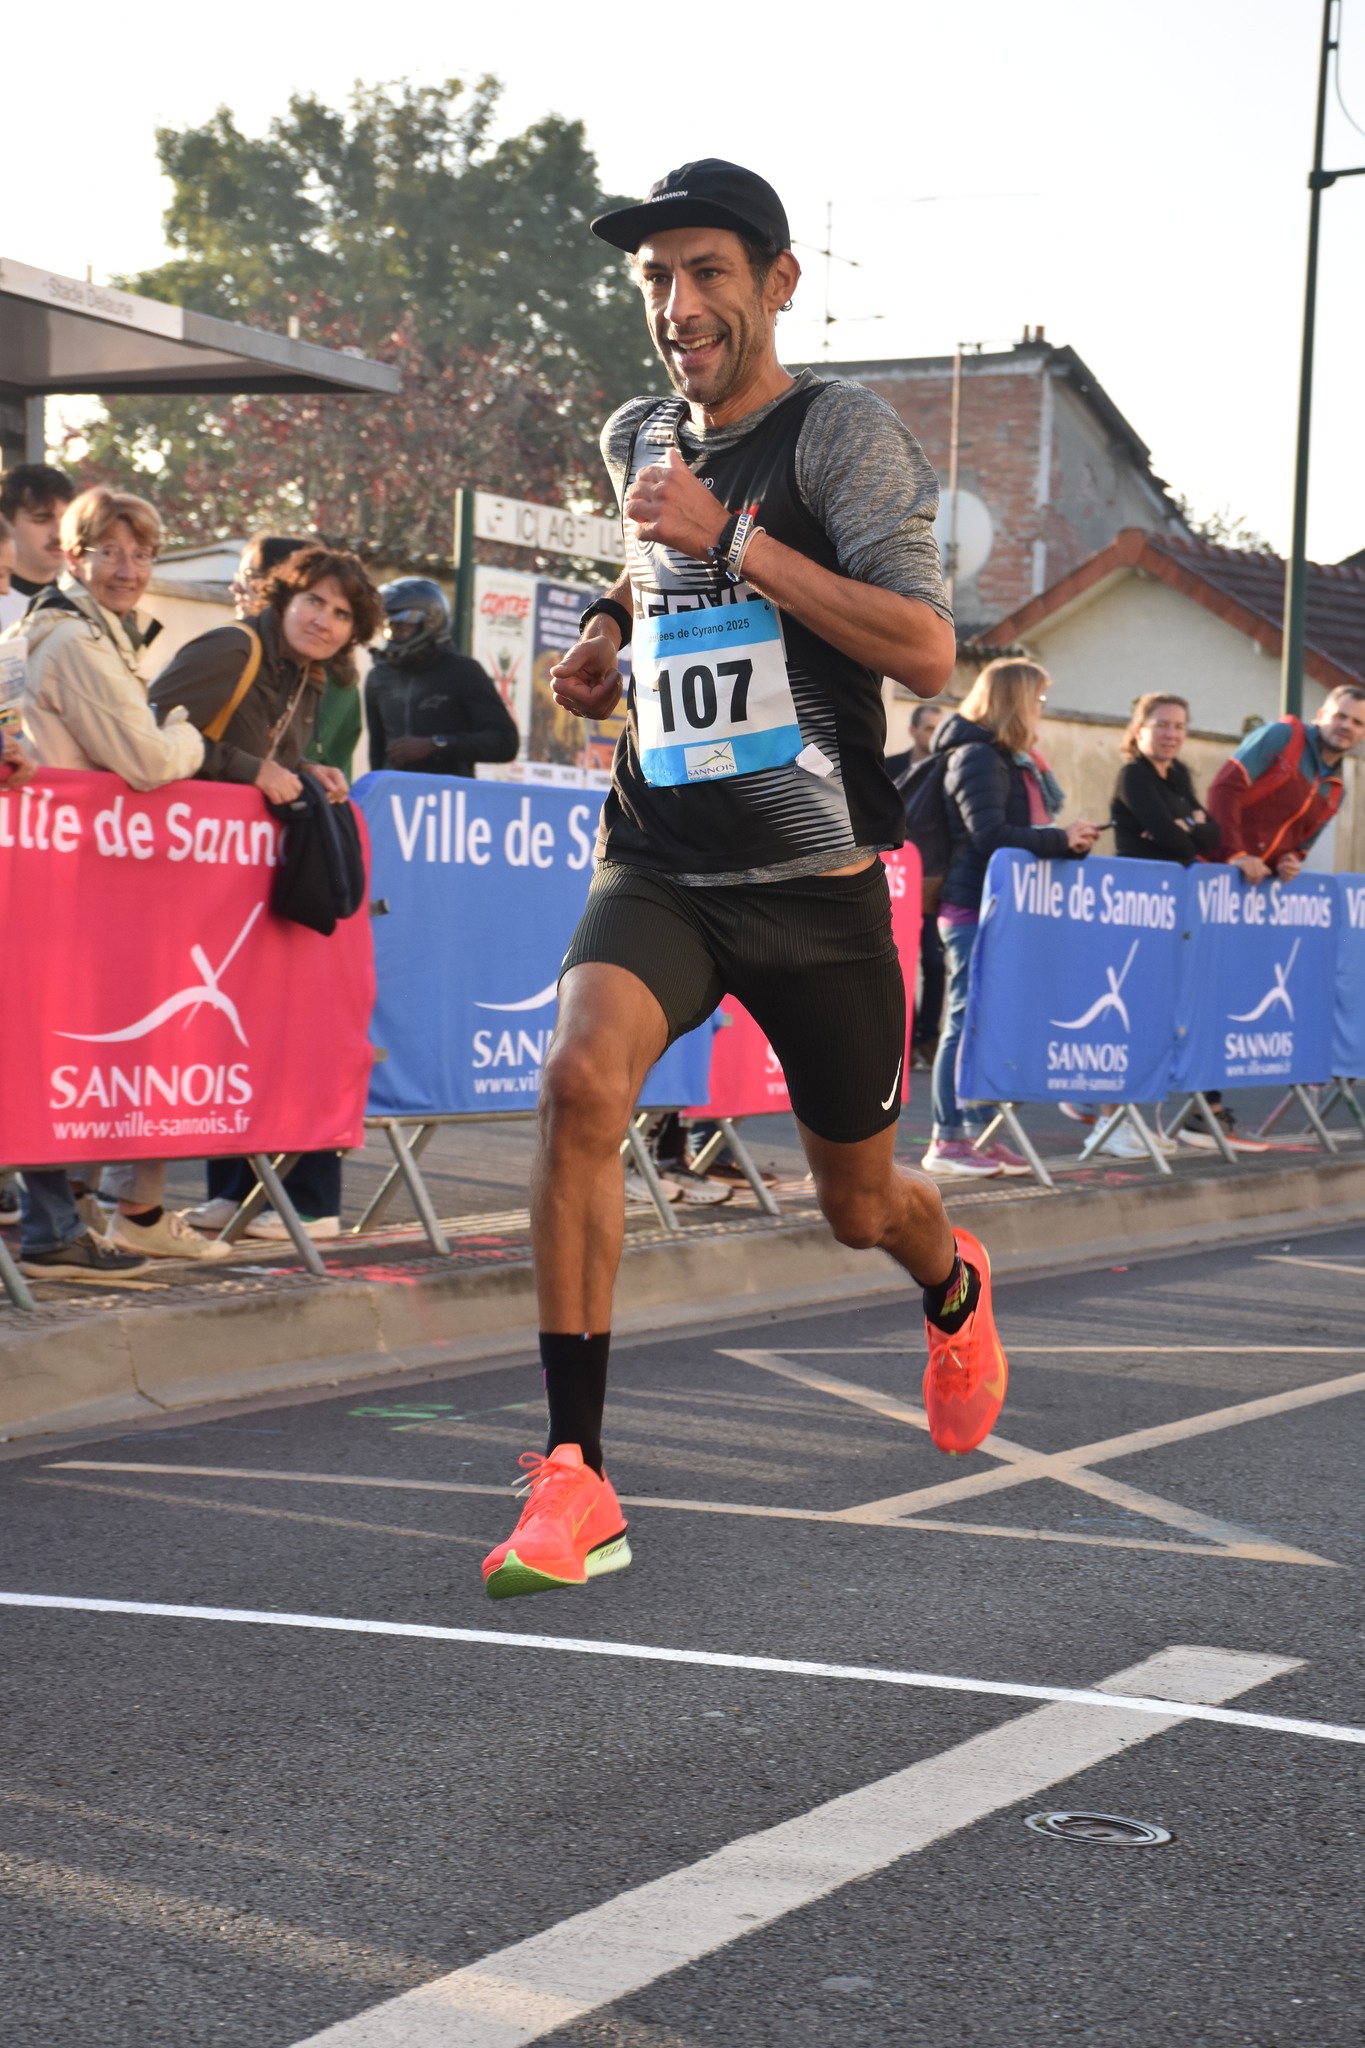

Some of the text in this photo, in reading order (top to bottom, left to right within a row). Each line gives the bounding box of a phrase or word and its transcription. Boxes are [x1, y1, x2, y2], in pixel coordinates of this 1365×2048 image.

[728, 549, 739, 564] ALL
[734, 527, 745, 547] STAR
[648, 618, 750, 644] oulées de Cyrano 2025
[652, 658, 753, 733] 107
[688, 762, 735, 777] SANNOIS
[0, 786, 287, 868] ille de Sann
[390, 789, 602, 871] Ville de S
[1012, 860, 1176, 930] Ville de Sannois
[1198, 873, 1332, 928] Ville de Sannois
[1047, 1041, 1129, 1072] SANNOIS
[1224, 1031, 1293, 1060] SANNOIS
[50, 1063, 253, 1109] SANNOIS
[52, 1109, 251, 1140] www.ville-sannois.fr
